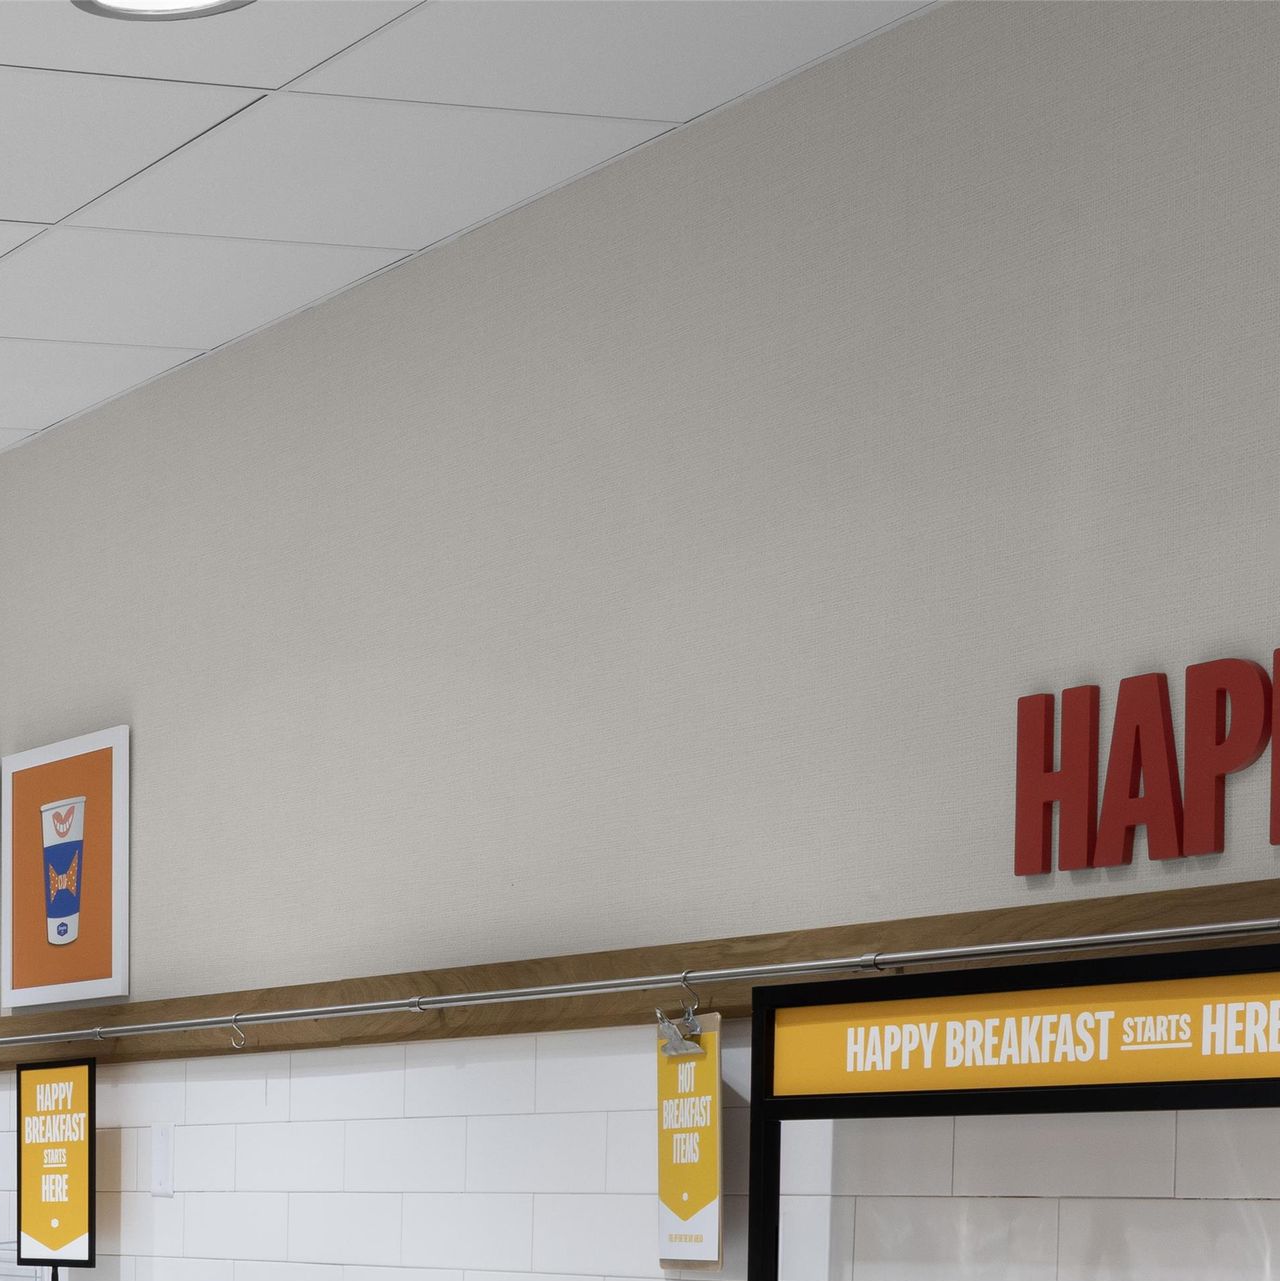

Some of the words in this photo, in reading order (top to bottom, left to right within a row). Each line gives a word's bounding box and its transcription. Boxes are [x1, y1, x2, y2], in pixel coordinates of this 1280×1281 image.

[1014, 648, 1280, 877] HAP
[846, 1022, 938, 1073] HAPPY
[945, 1010, 1115, 1068] BREAKFAST
[1122, 1013, 1192, 1043] STARTS
[1201, 1000, 1280, 1056] HERE
[678, 1061, 696, 1094] HOT
[36, 1081, 74, 1112] HAPPY
[662, 1095, 712, 1130] BREAKFAST
[24, 1112, 86, 1144] BREAKFAST
[43, 1148, 67, 1164] STARTS
[672, 1132, 700, 1164] ITEMS
[41, 1173, 69, 1203] HERE
